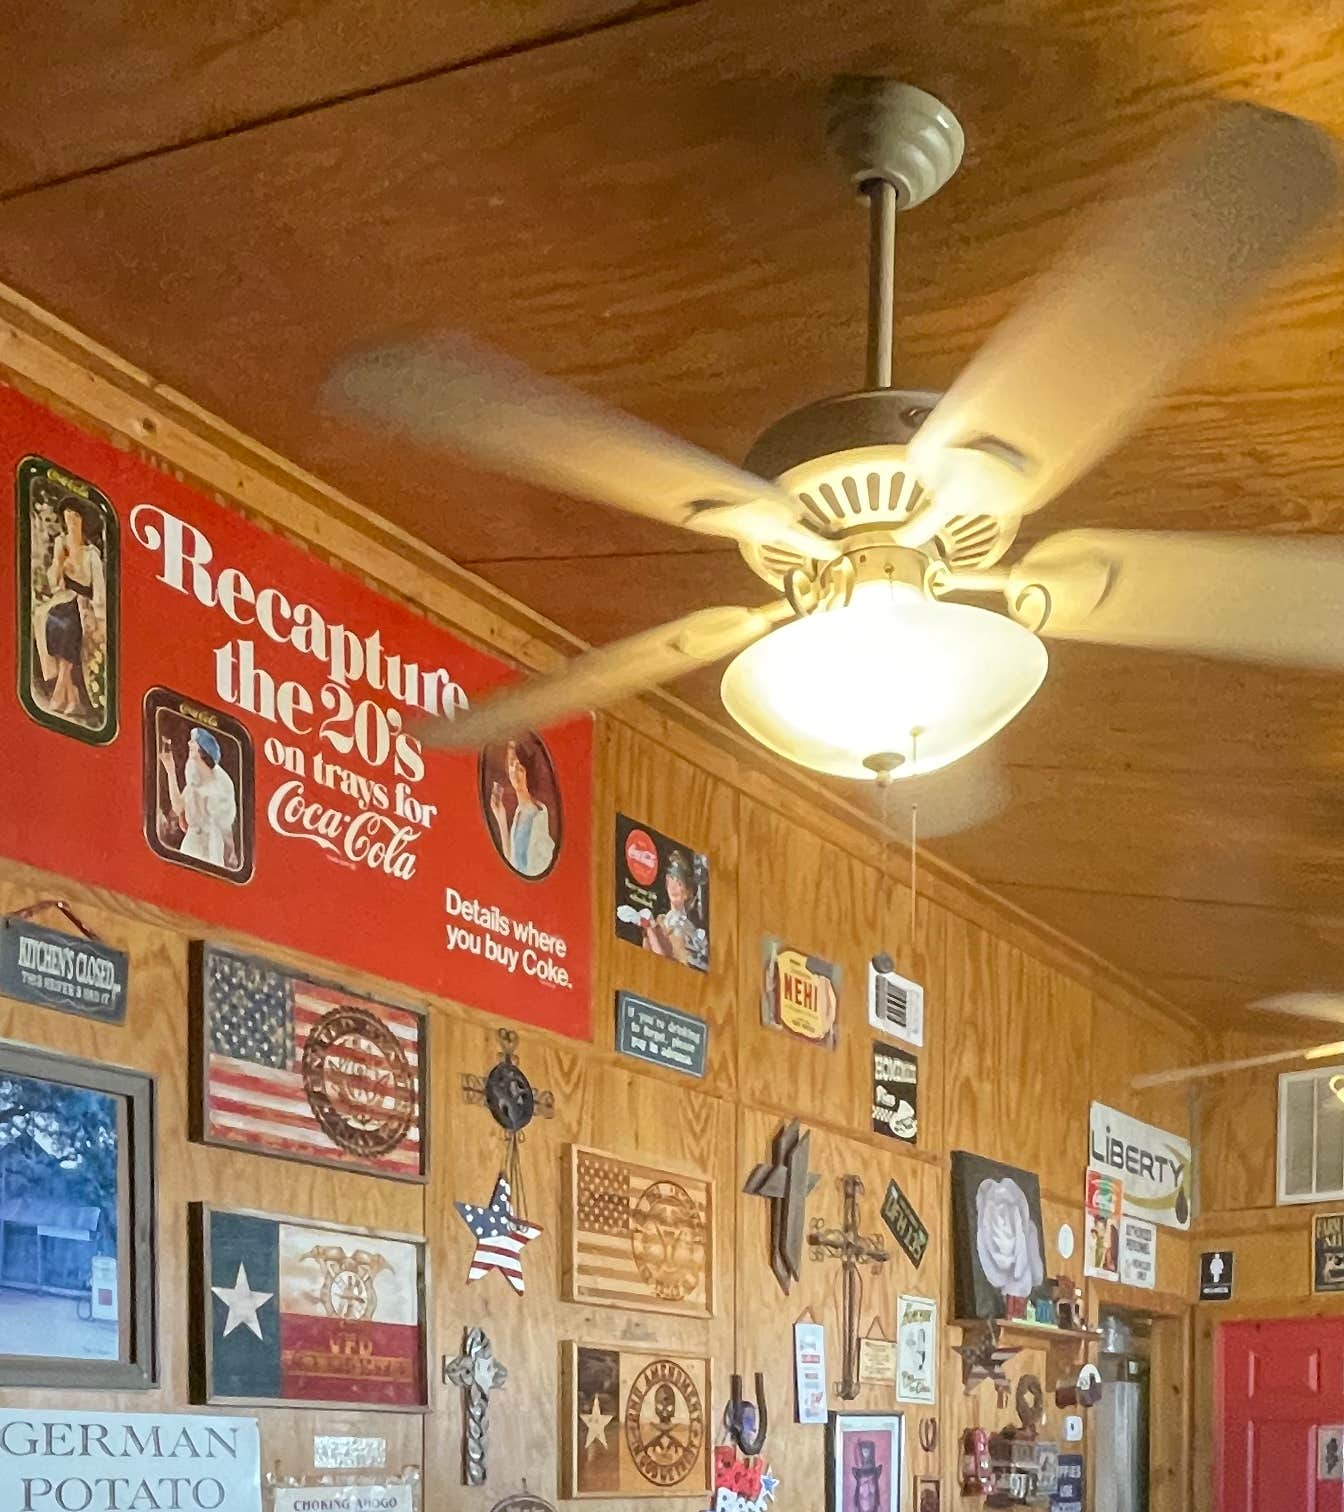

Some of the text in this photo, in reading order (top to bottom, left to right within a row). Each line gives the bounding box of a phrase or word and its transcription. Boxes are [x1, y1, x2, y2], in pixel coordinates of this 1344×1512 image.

[129, 502, 472, 723] Recapture
[213, 639, 425, 785] the 20's
[264, 735, 439, 832] on trays for
[266, 779, 421, 883] Coca-Cola
[18, 936, 76, 980] KITCHEN'S
[445, 886, 569, 958] Details where
[445, 922, 574, 991] you buy Coke.
[782, 971, 819, 1013] NEHI
[293, 1498, 351, 1512] CHOKING
